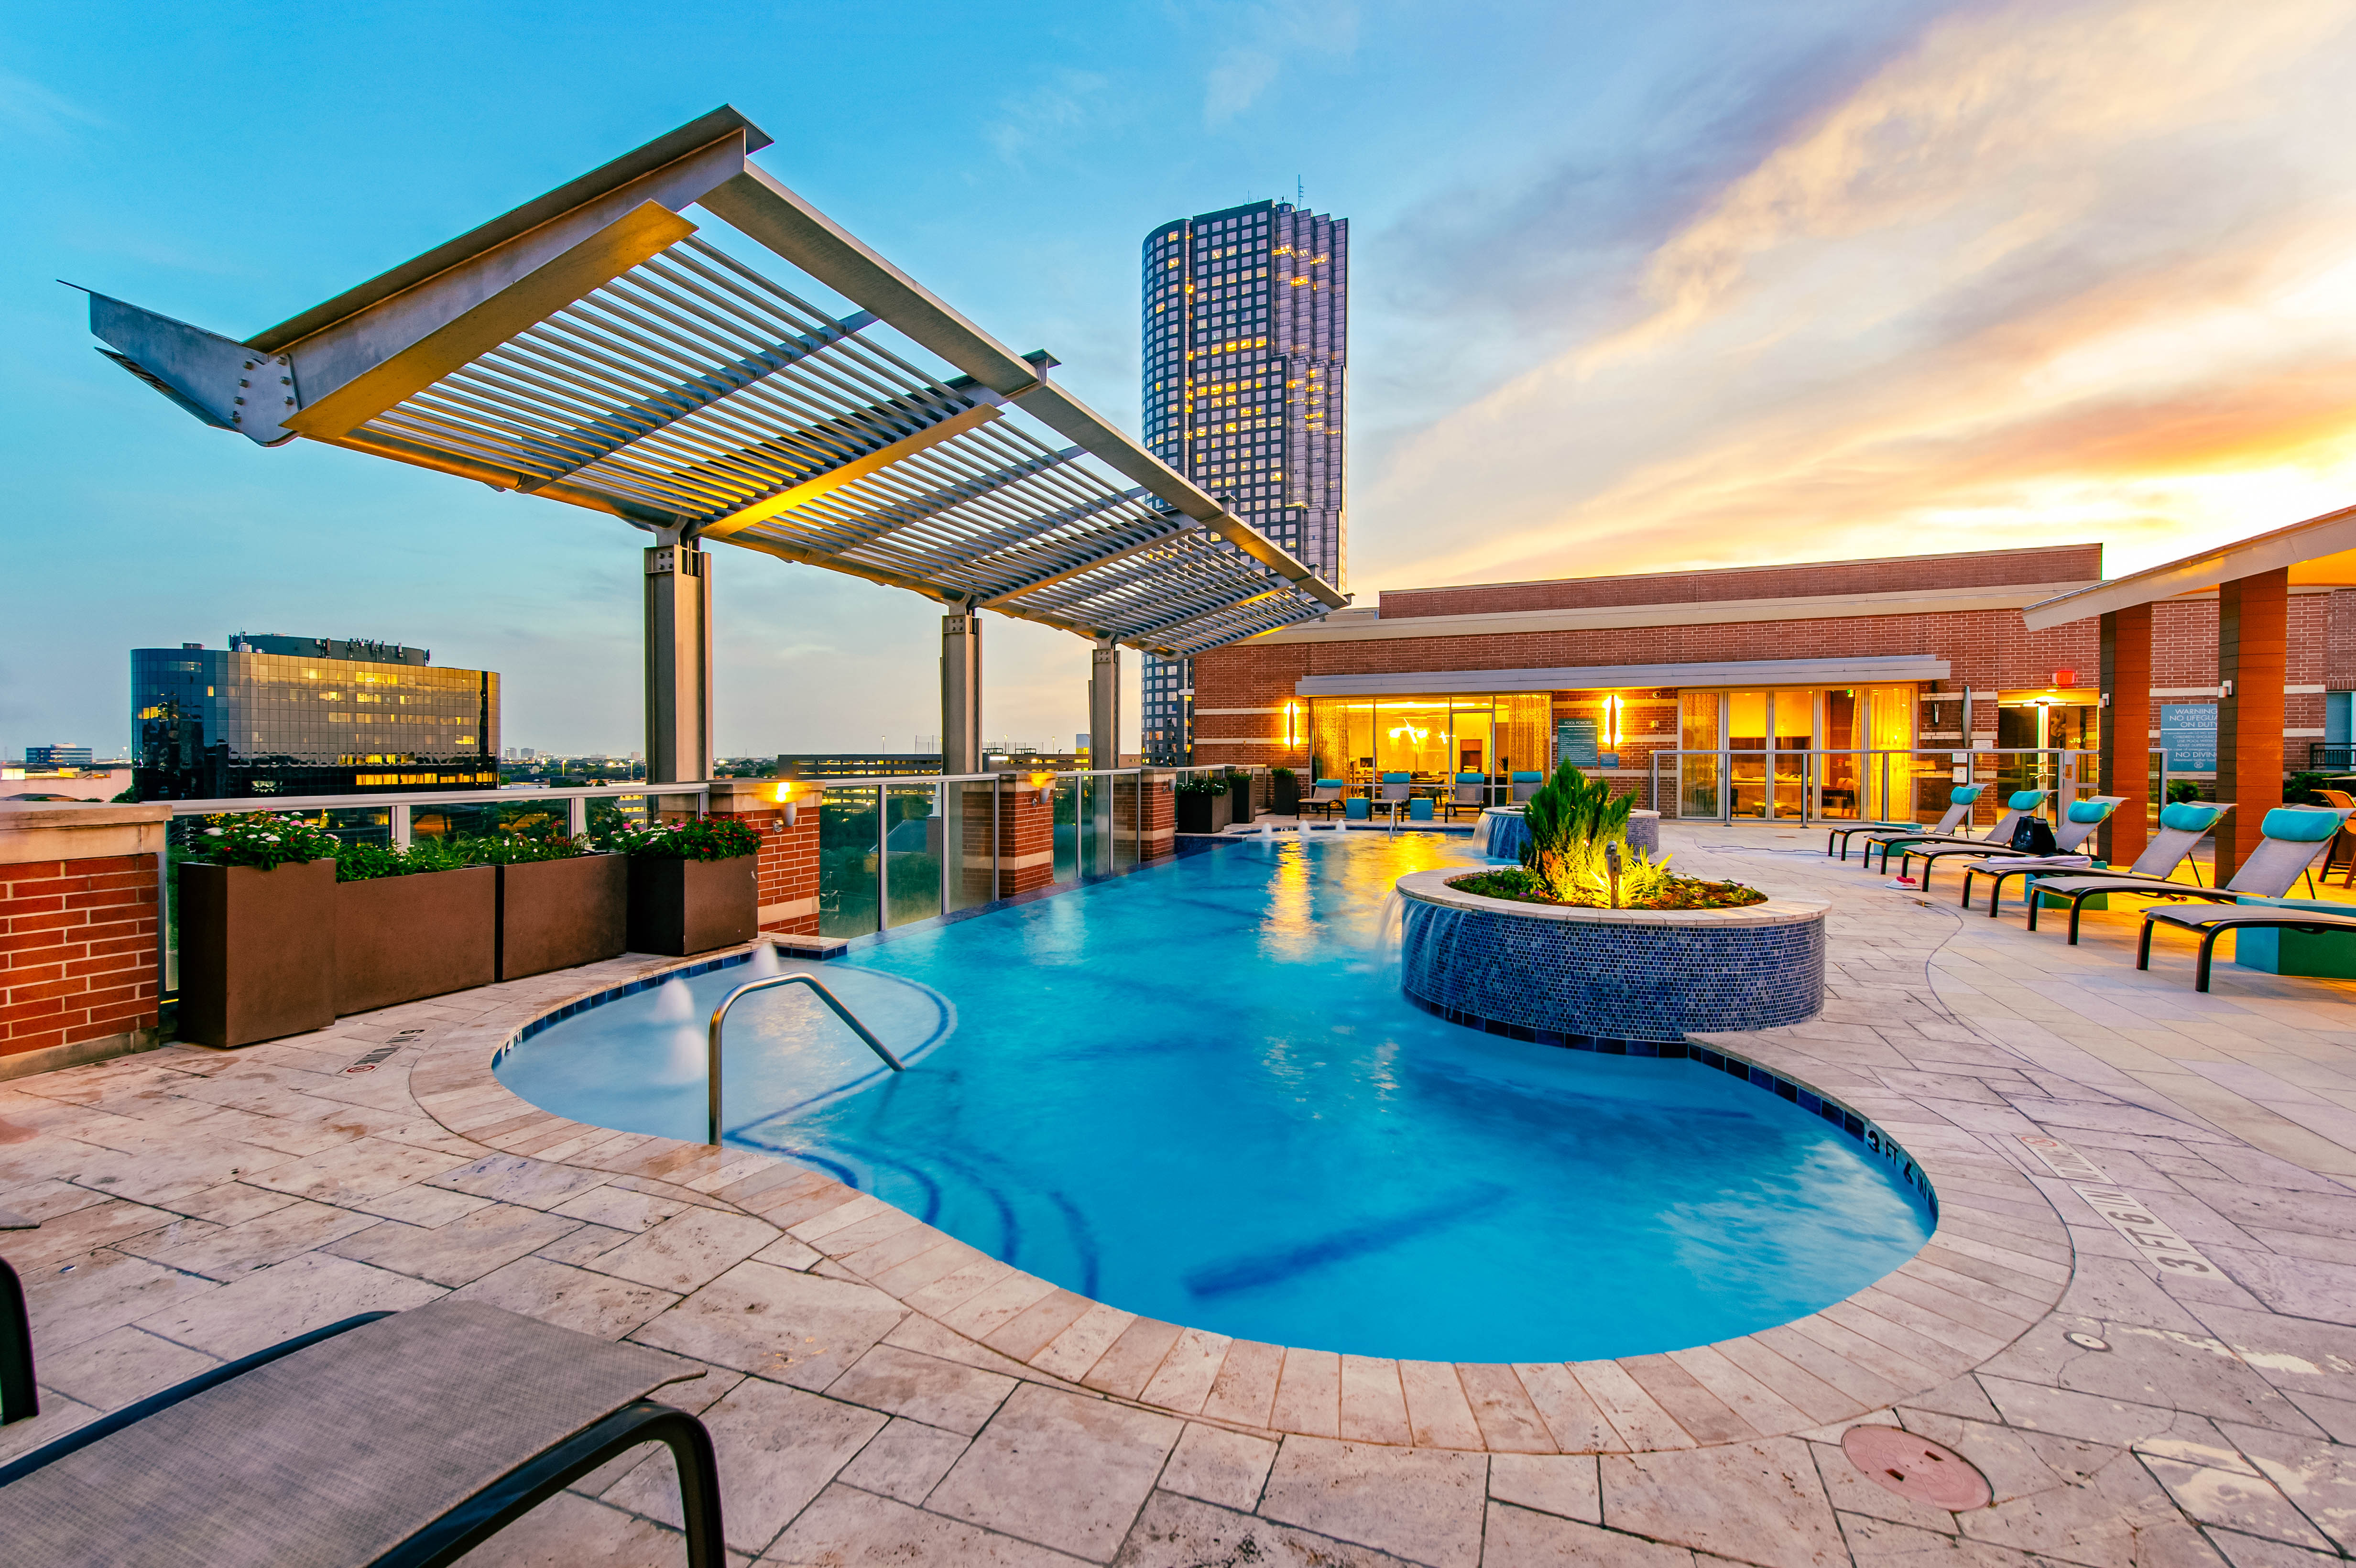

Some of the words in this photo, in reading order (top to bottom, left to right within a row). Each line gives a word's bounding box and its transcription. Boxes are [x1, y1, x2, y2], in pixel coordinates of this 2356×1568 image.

[1867, 1130, 1880, 1154] 3
[1885, 1139, 1898, 1167] FT
[1917, 1173, 1927, 1202] IN
[2081, 1189, 2137, 1207] IN
[2107, 1211, 2154, 1224] 6
[2124, 1227, 2189, 1252] FT
[2157, 1256, 2210, 1272] 3
